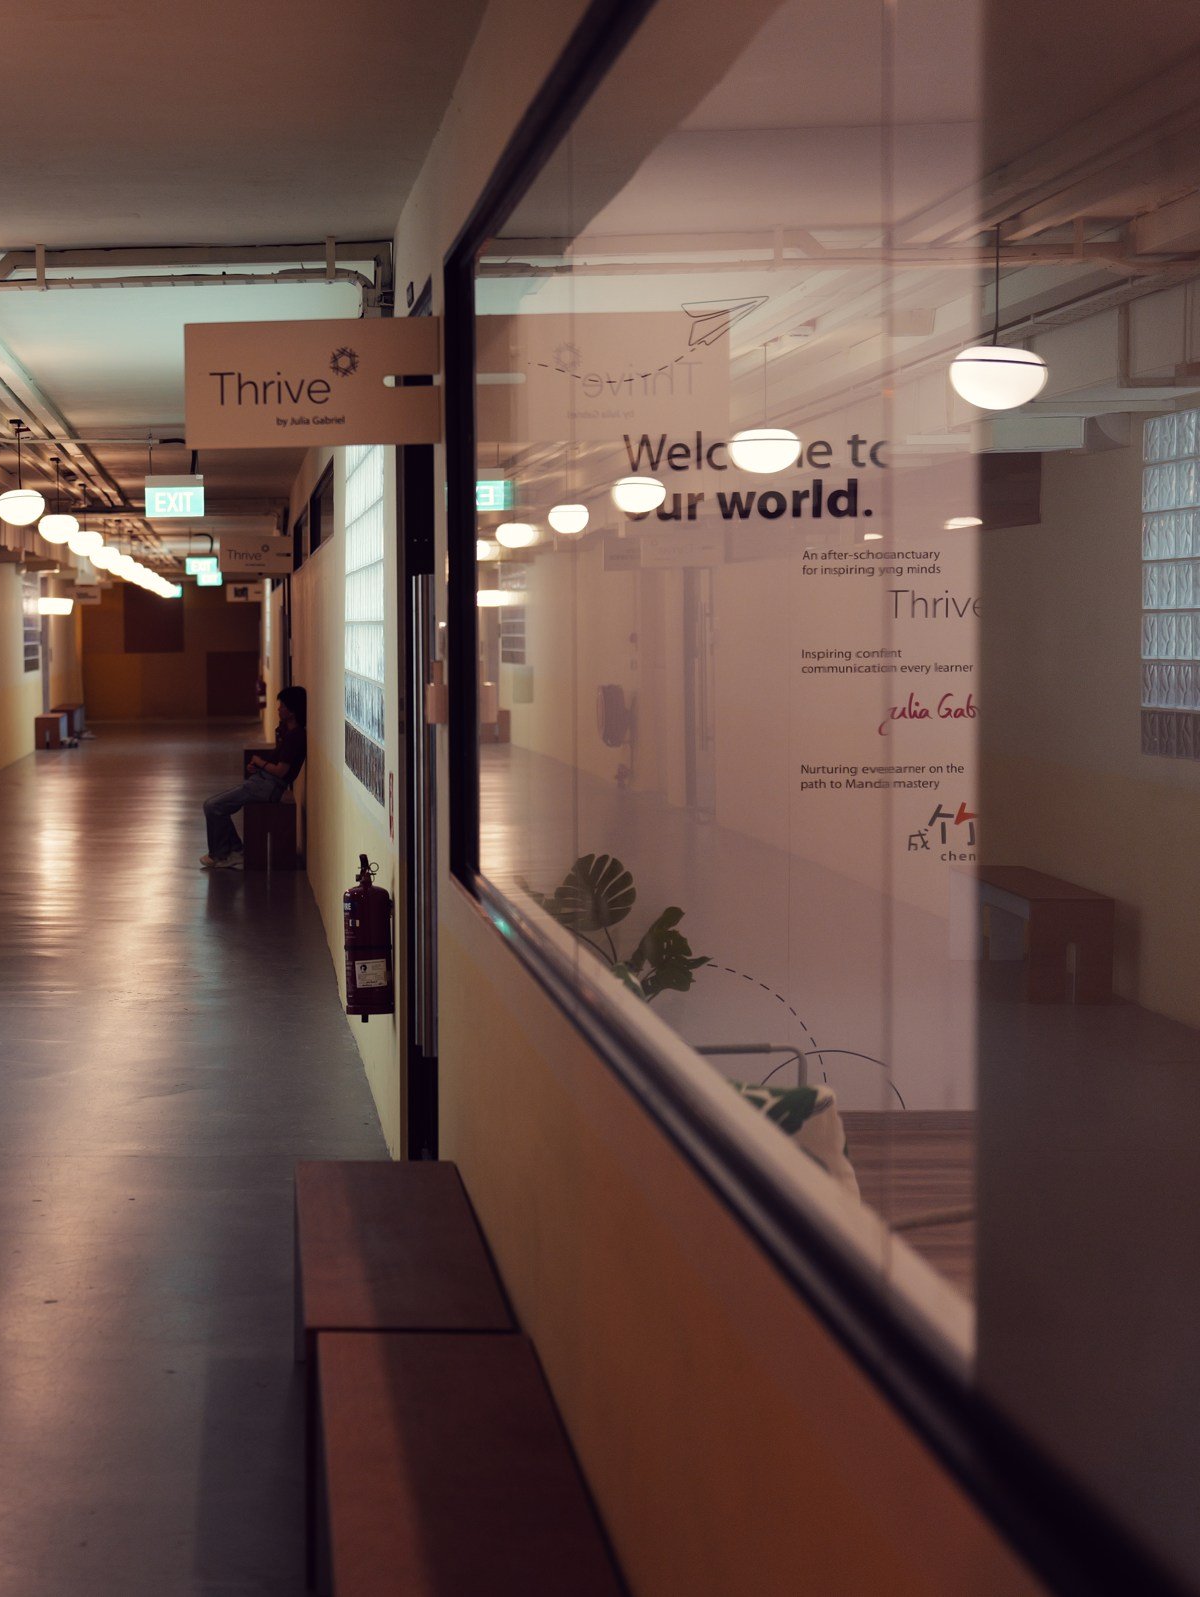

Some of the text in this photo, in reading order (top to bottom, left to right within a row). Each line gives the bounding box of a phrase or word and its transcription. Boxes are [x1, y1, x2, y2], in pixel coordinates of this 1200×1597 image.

[209, 371, 331, 405] Thrive
[276, 415, 346, 427] by Julia Gabriel
[623, 430, 833, 472] Welce
[155, 491, 194, 513] EXIT
[624, 478, 873, 521] ur world.
[227, 549, 262, 561] Thrive
[802, 550, 818, 560] An
[802, 565, 818, 576] for
[820, 565, 875, 577] inspiring
[907, 564, 941, 575] minds
[801, 649, 852, 661] Inspiring
[900, 664, 931, 675] every
[934, 663, 973, 673] learner
[801, 764, 858, 777] Nurturing
[929, 765, 943, 774] on
[946, 763, 965, 774] the
[800, 778, 827, 791] path
[830, 779, 842, 789] to
[893, 779, 940, 790] mastery
[940, 851, 976, 861] chen
